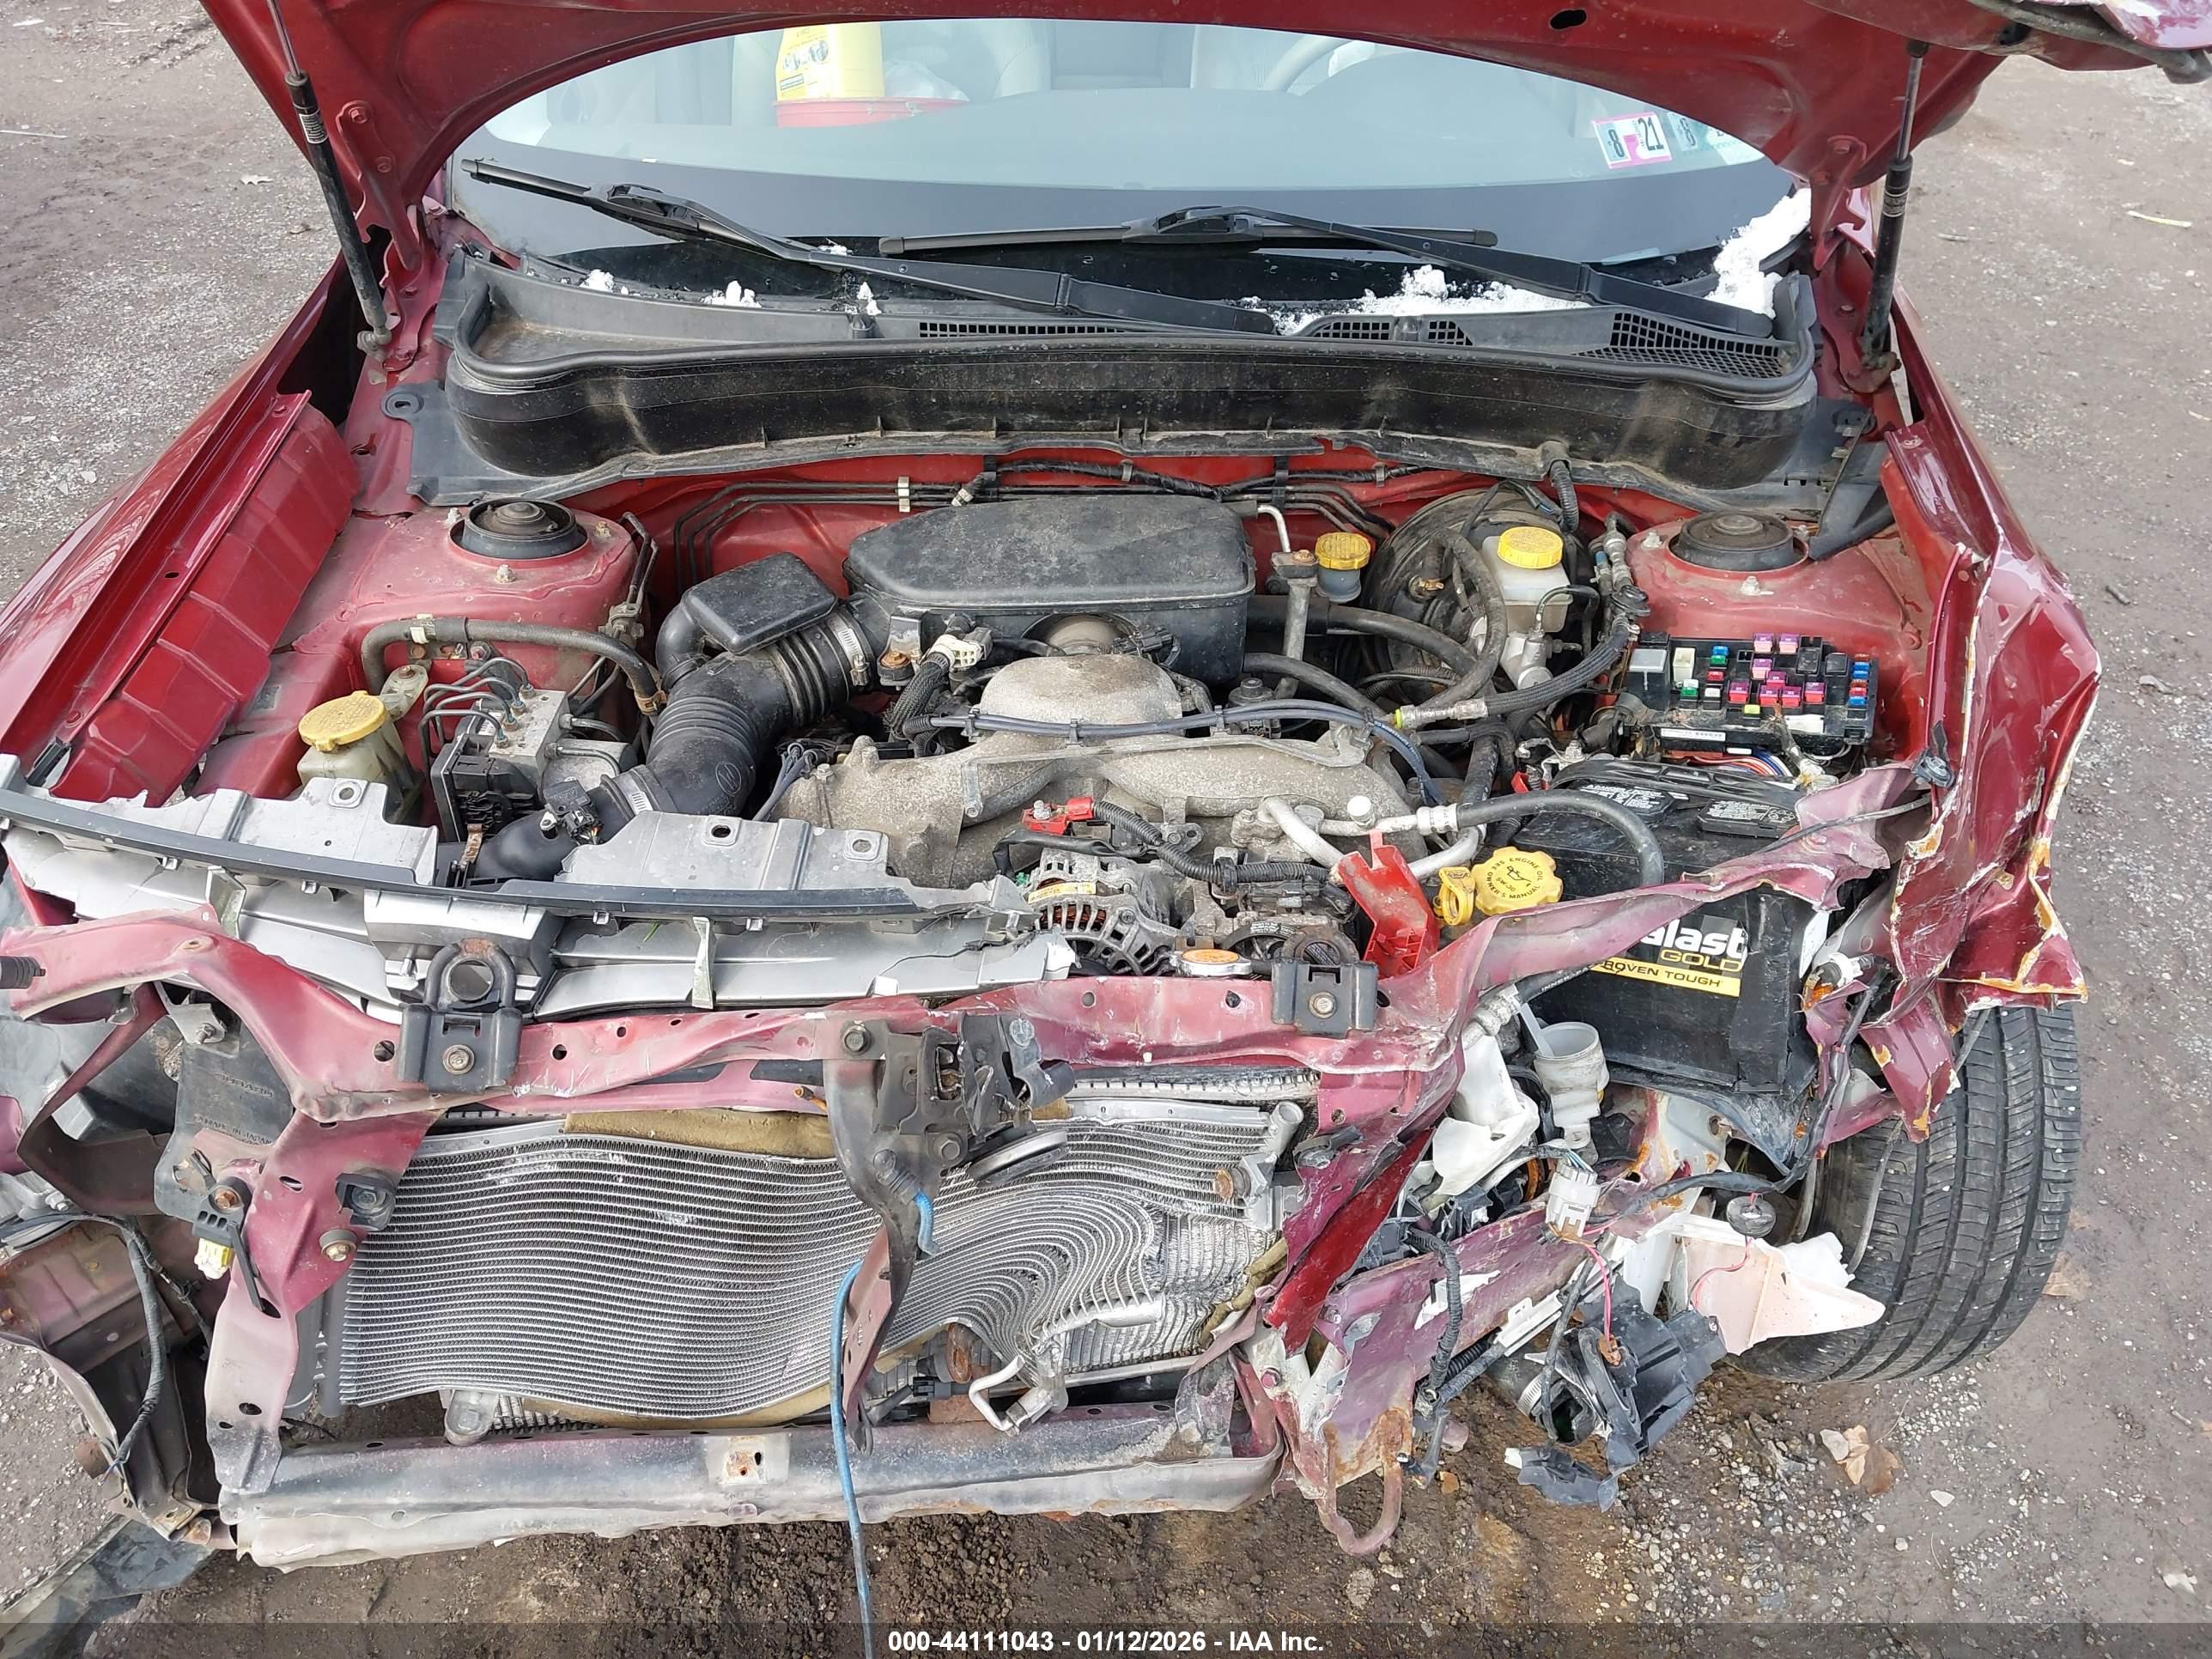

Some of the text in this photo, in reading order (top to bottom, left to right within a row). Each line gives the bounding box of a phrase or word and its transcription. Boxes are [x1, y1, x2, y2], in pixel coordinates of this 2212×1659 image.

[1608, 129, 1625, 157] 8
[1638, 116, 1664, 151] 21
[1509, 857, 1540, 869] ENGINE
[1491, 860, 1505, 871] SEE
[1509, 885, 1540, 899] MANUAL
[1660, 949, 1743, 973] GOLD
[1664, 970, 1722, 988] TOUGH
